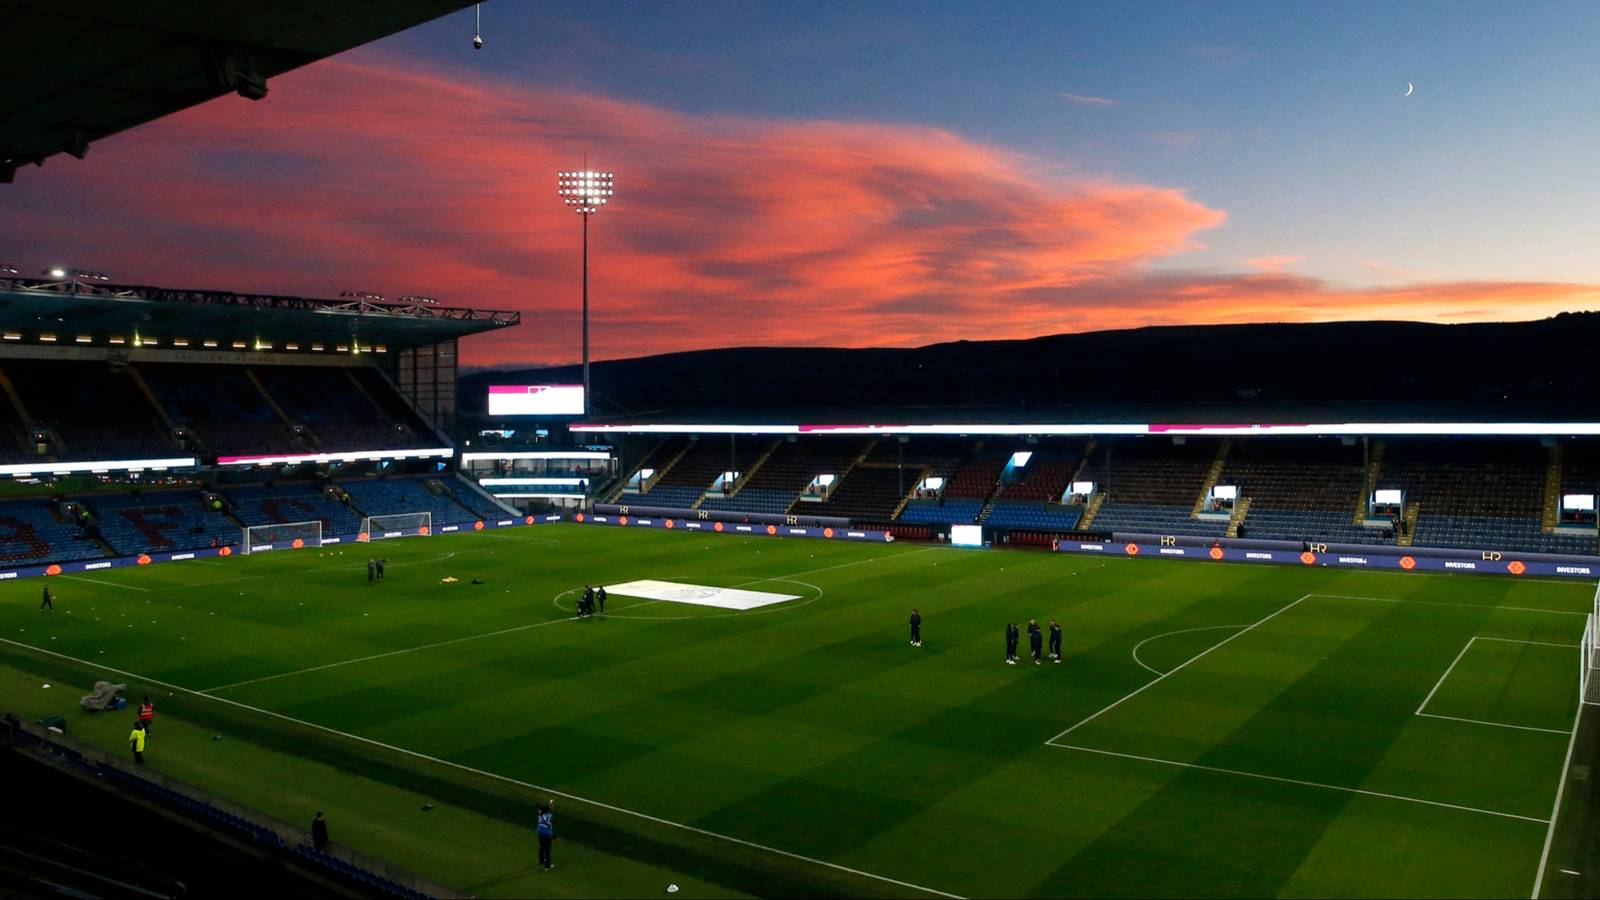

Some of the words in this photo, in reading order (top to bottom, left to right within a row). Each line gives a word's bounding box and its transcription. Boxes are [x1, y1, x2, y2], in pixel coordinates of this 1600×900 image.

[698, 509, 709, 520] HR
[786, 515, 799, 526] HR
[1160, 535, 1176, 547] HR
[1444, 561, 1476, 570] INVESTORS
[1556, 566, 1591, 576] INVESTORS
